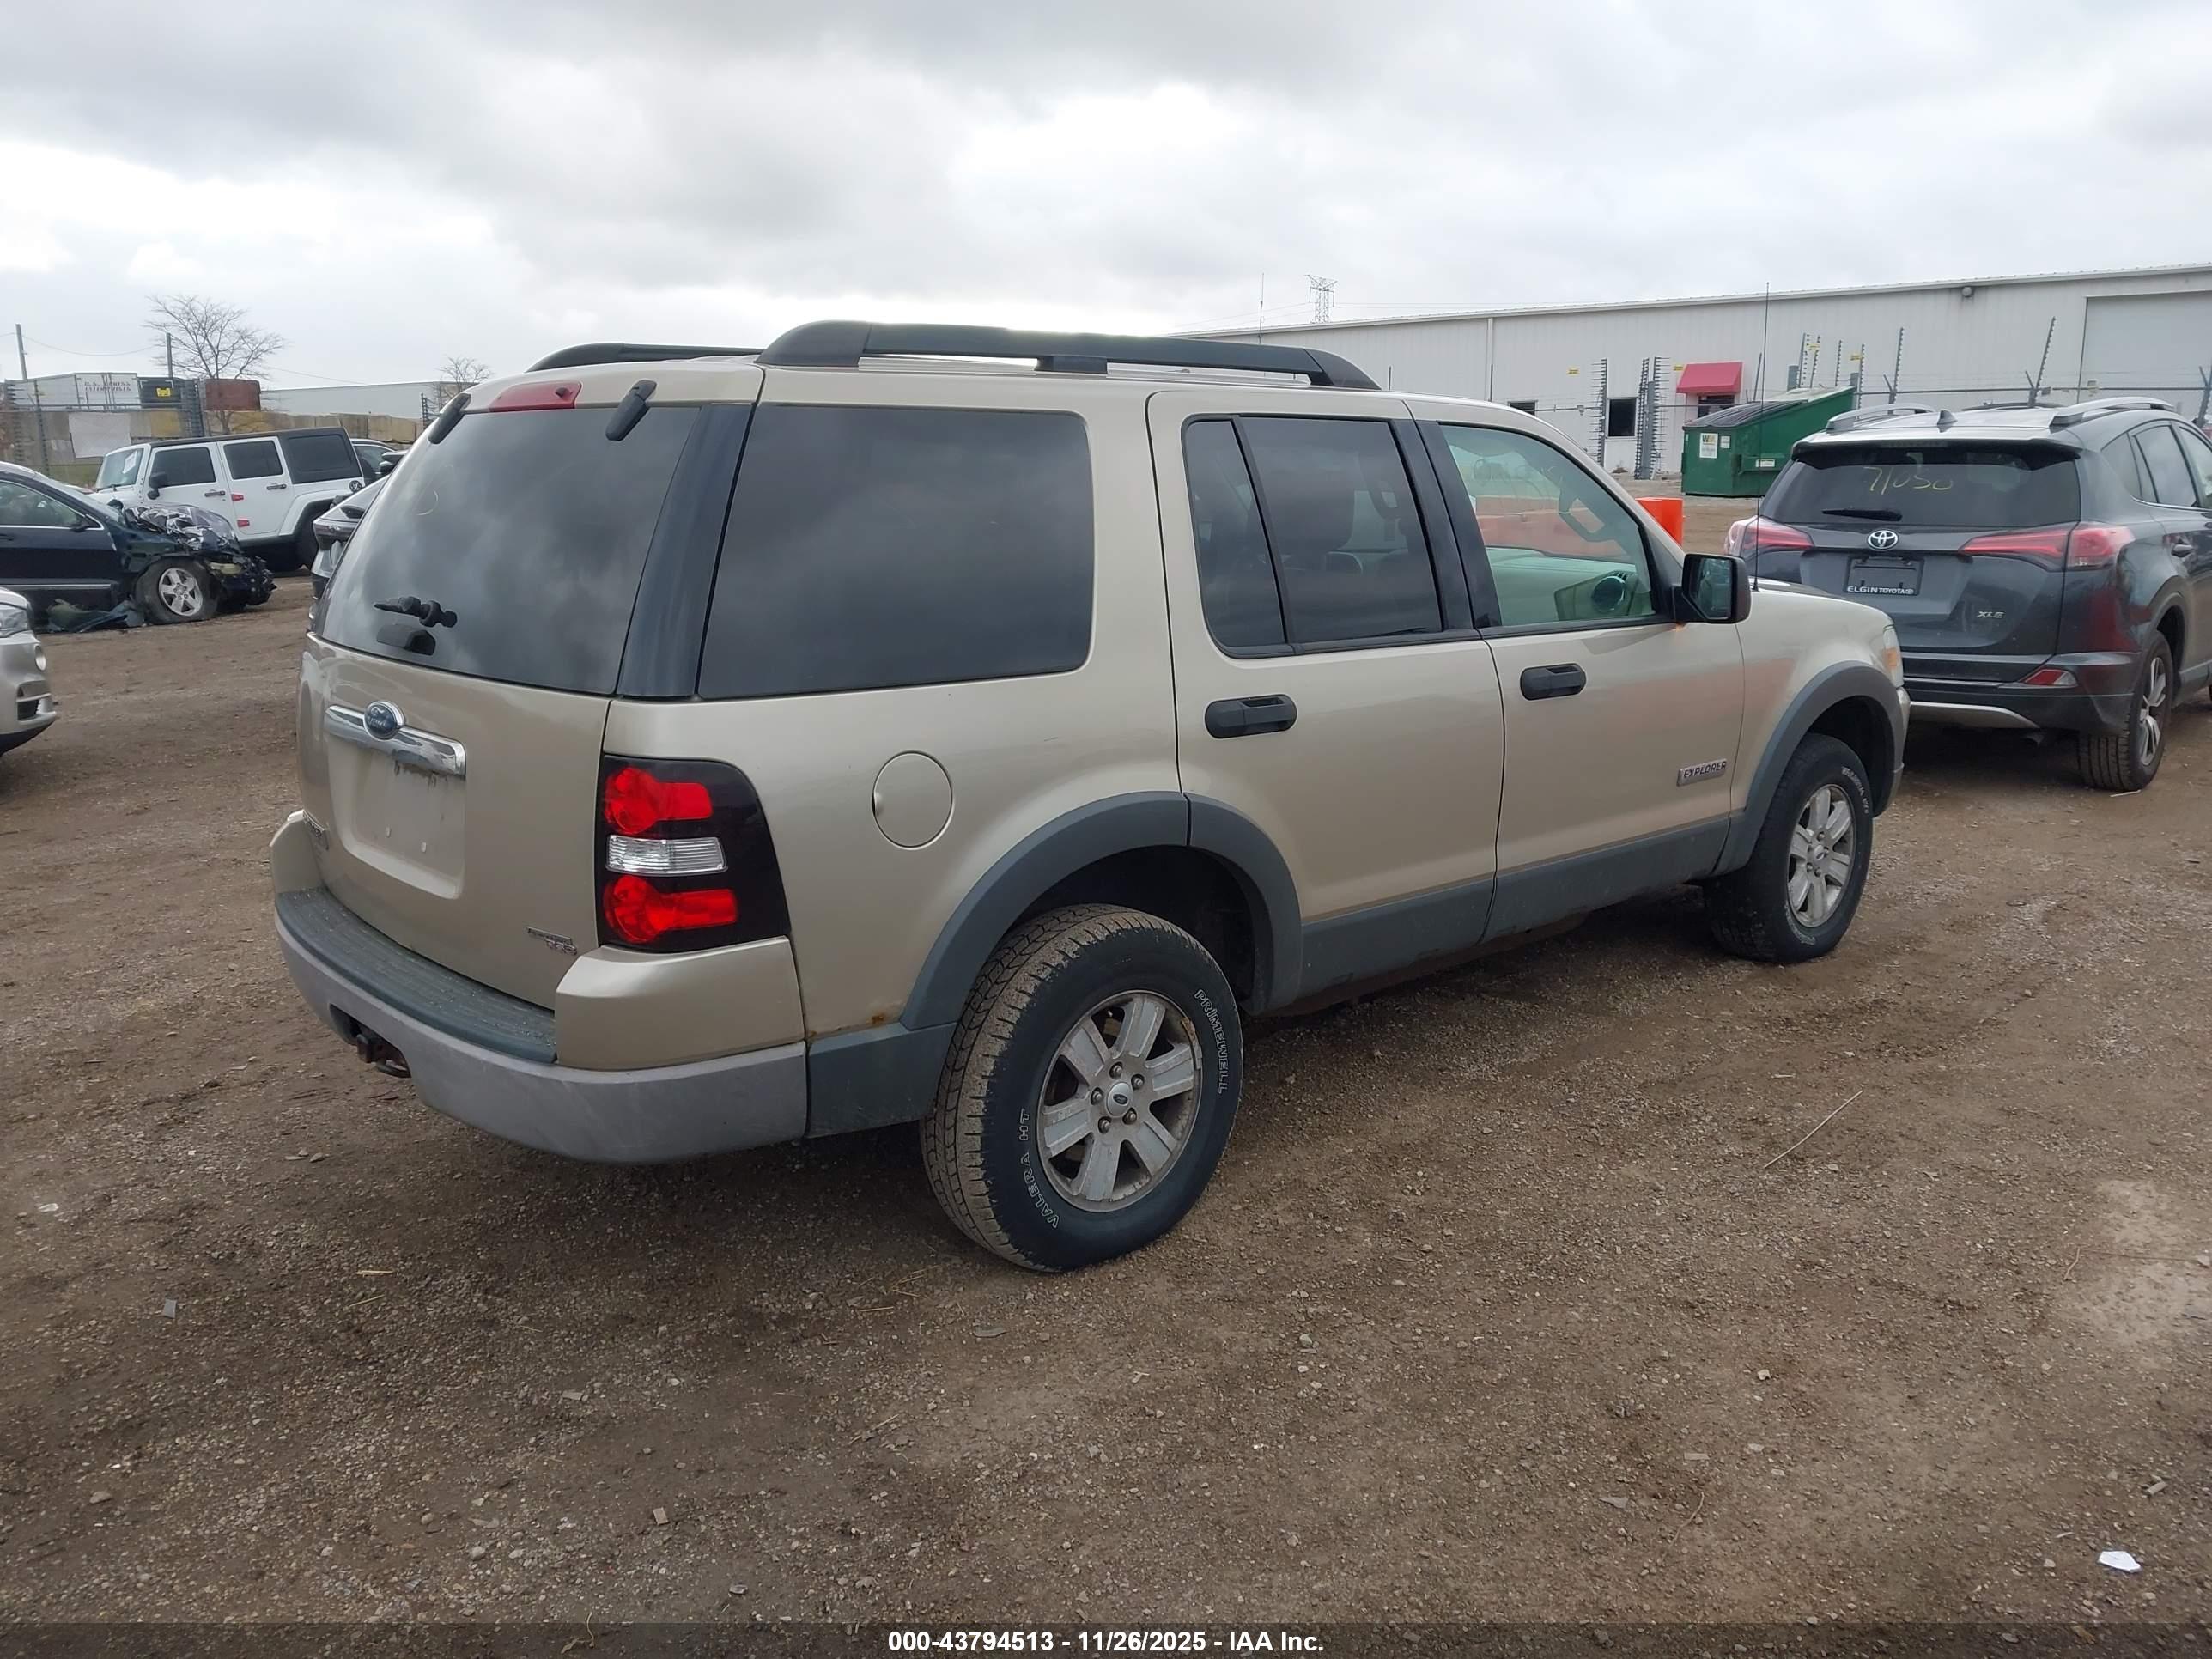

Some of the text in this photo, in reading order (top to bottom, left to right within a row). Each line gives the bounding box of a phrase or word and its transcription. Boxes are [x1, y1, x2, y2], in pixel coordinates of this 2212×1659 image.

[1847, 586, 1879, 594] ELGIN
[1683, 761, 1728, 779] EXPLORER
[1194, 988, 1229, 1095] PRIMEWELL
[1018, 1108, 1060, 1228] VALERA HT
